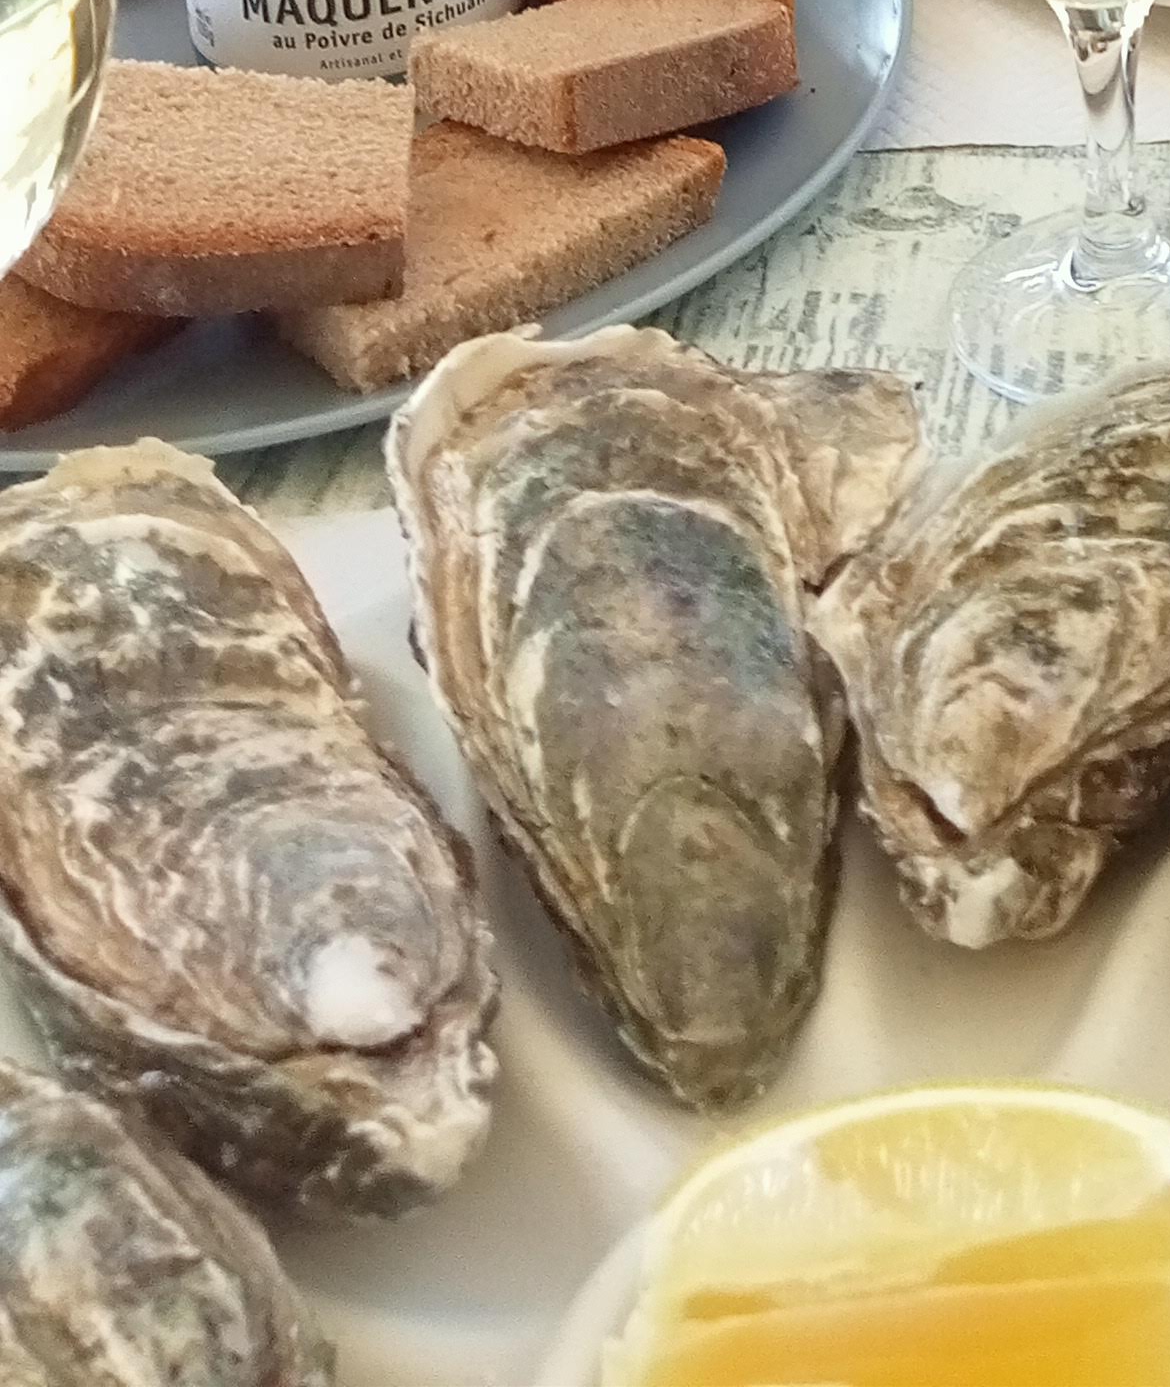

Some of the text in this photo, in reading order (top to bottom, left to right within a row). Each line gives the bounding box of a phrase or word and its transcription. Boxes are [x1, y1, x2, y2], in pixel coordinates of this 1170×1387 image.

[272, 33, 297, 51] au
[305, 29, 373, 51] Poivre
[382, 21, 408, 41] de
[320, 51, 382, 71] Artisanal
